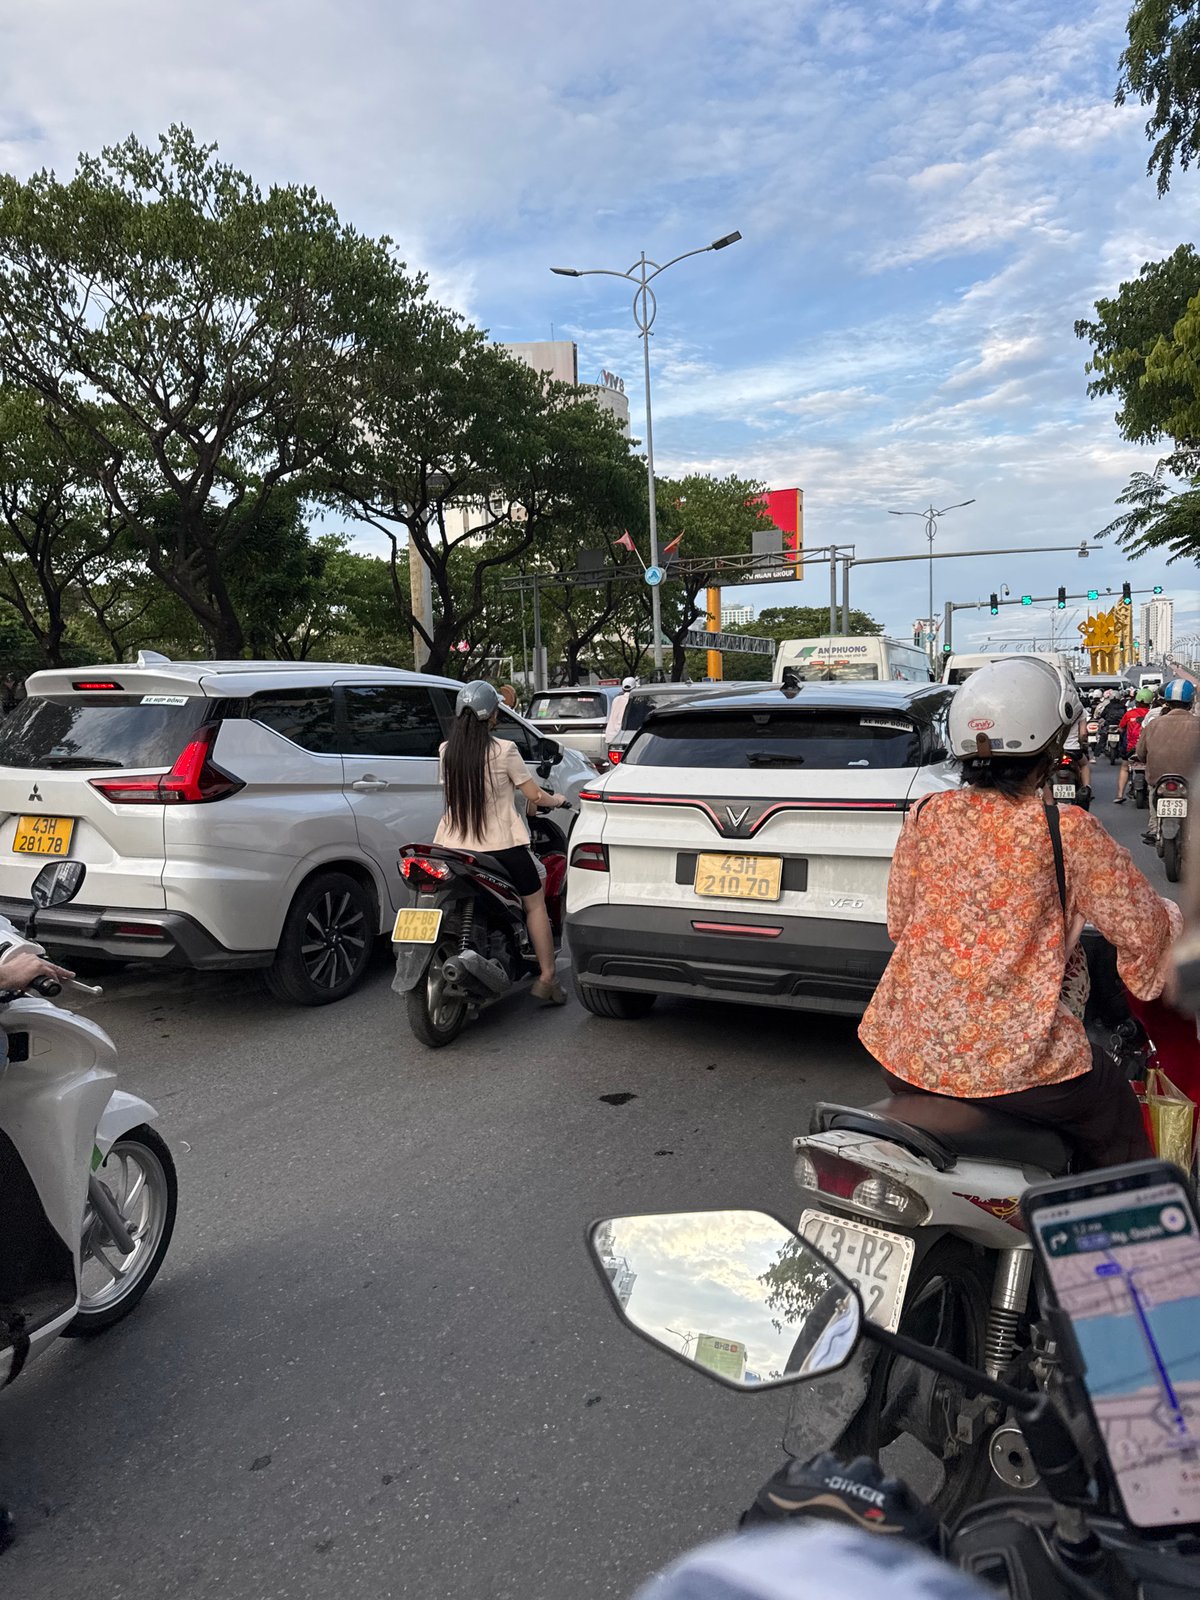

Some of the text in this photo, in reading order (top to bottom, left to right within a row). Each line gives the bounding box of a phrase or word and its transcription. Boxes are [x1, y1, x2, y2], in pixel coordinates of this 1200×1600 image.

[818, 647, 830, 655] AN
[32, 817, 56, 835] 43H
[19, 836, 62, 853] 281.78
[720, 855, 758, 875] 43H
[703, 875, 770, 897] 210.70
